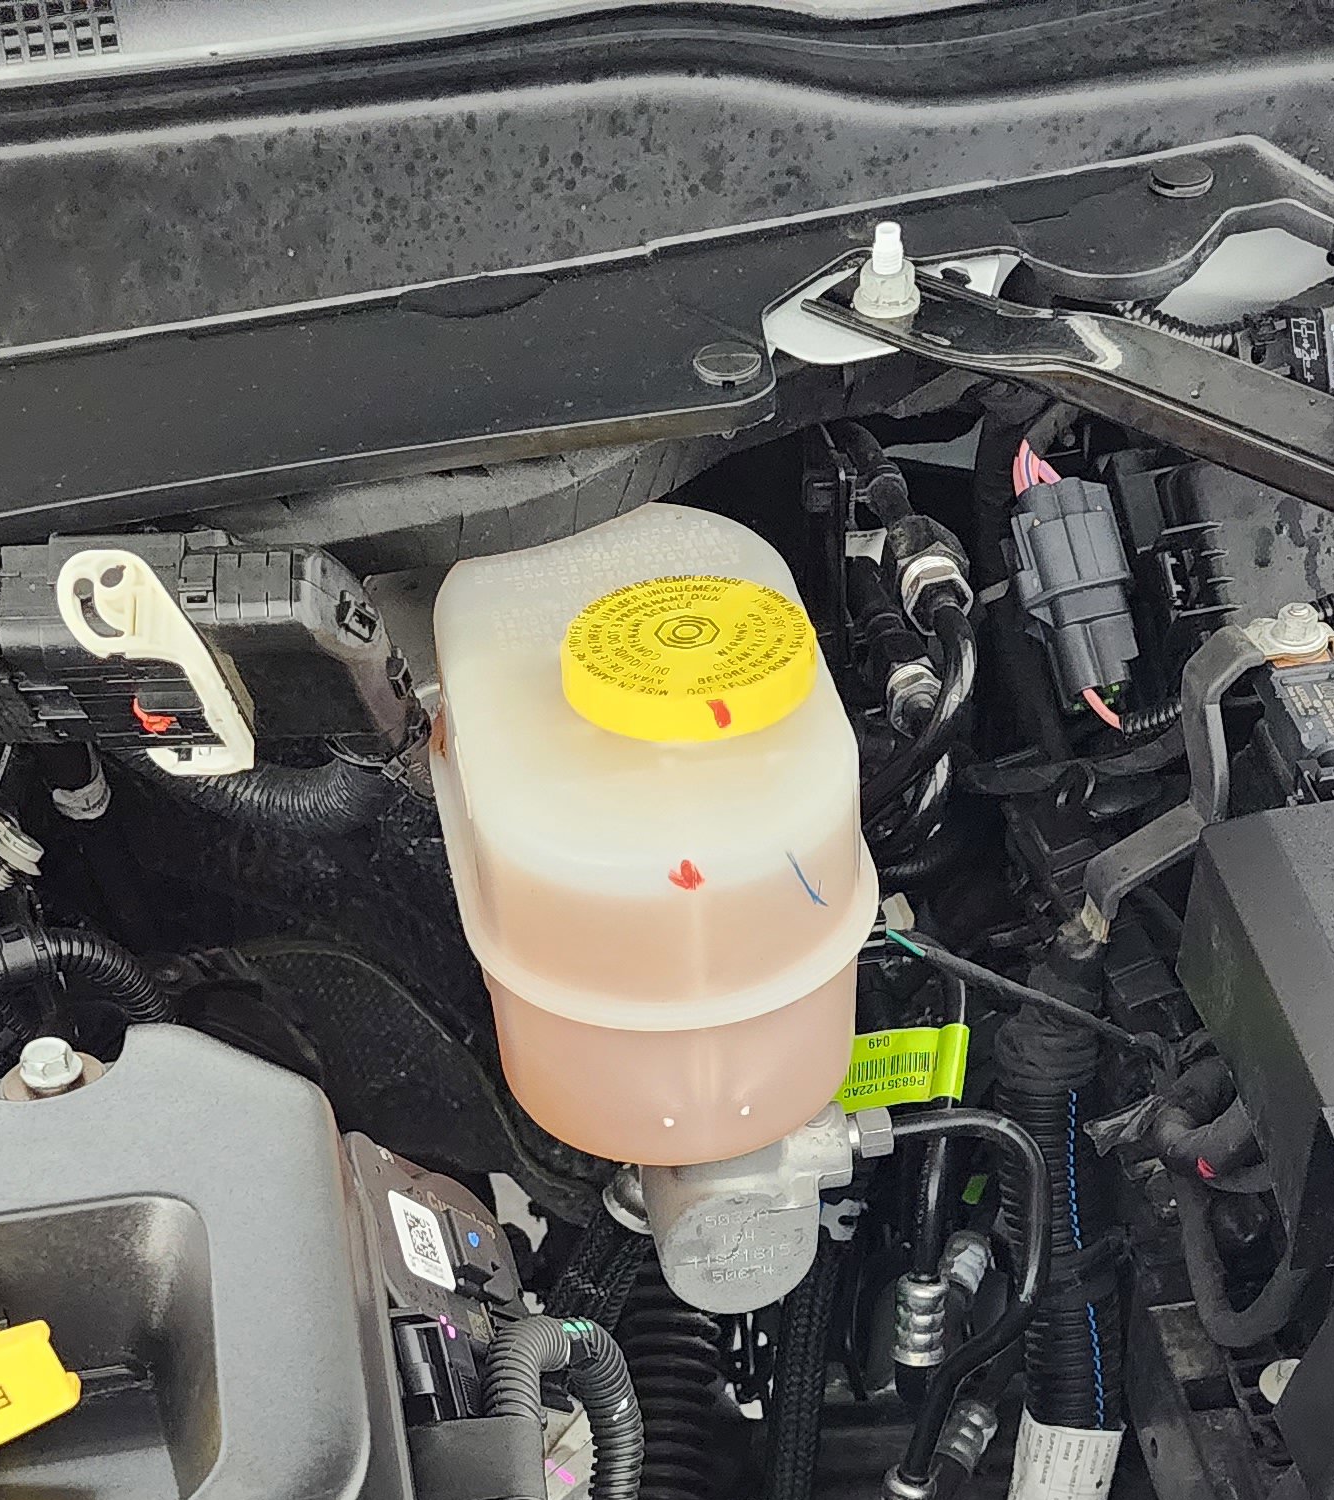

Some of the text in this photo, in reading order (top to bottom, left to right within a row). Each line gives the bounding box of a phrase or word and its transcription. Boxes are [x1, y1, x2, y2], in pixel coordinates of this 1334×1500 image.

[631, 579, 654, 590] DE
[652, 574, 744, 588] REMPLISSAGE
[637, 583, 729, 598] UNIQUEMENT
[613, 593, 684, 623] PROVENANT
[607, 645, 652, 671] LIQUIDE
[710, 651, 753, 670] CLEAN
[648, 664, 671, 676] DU
[696, 666, 751, 684] BEFORE
[867, 1035, 890, 1049] 049
